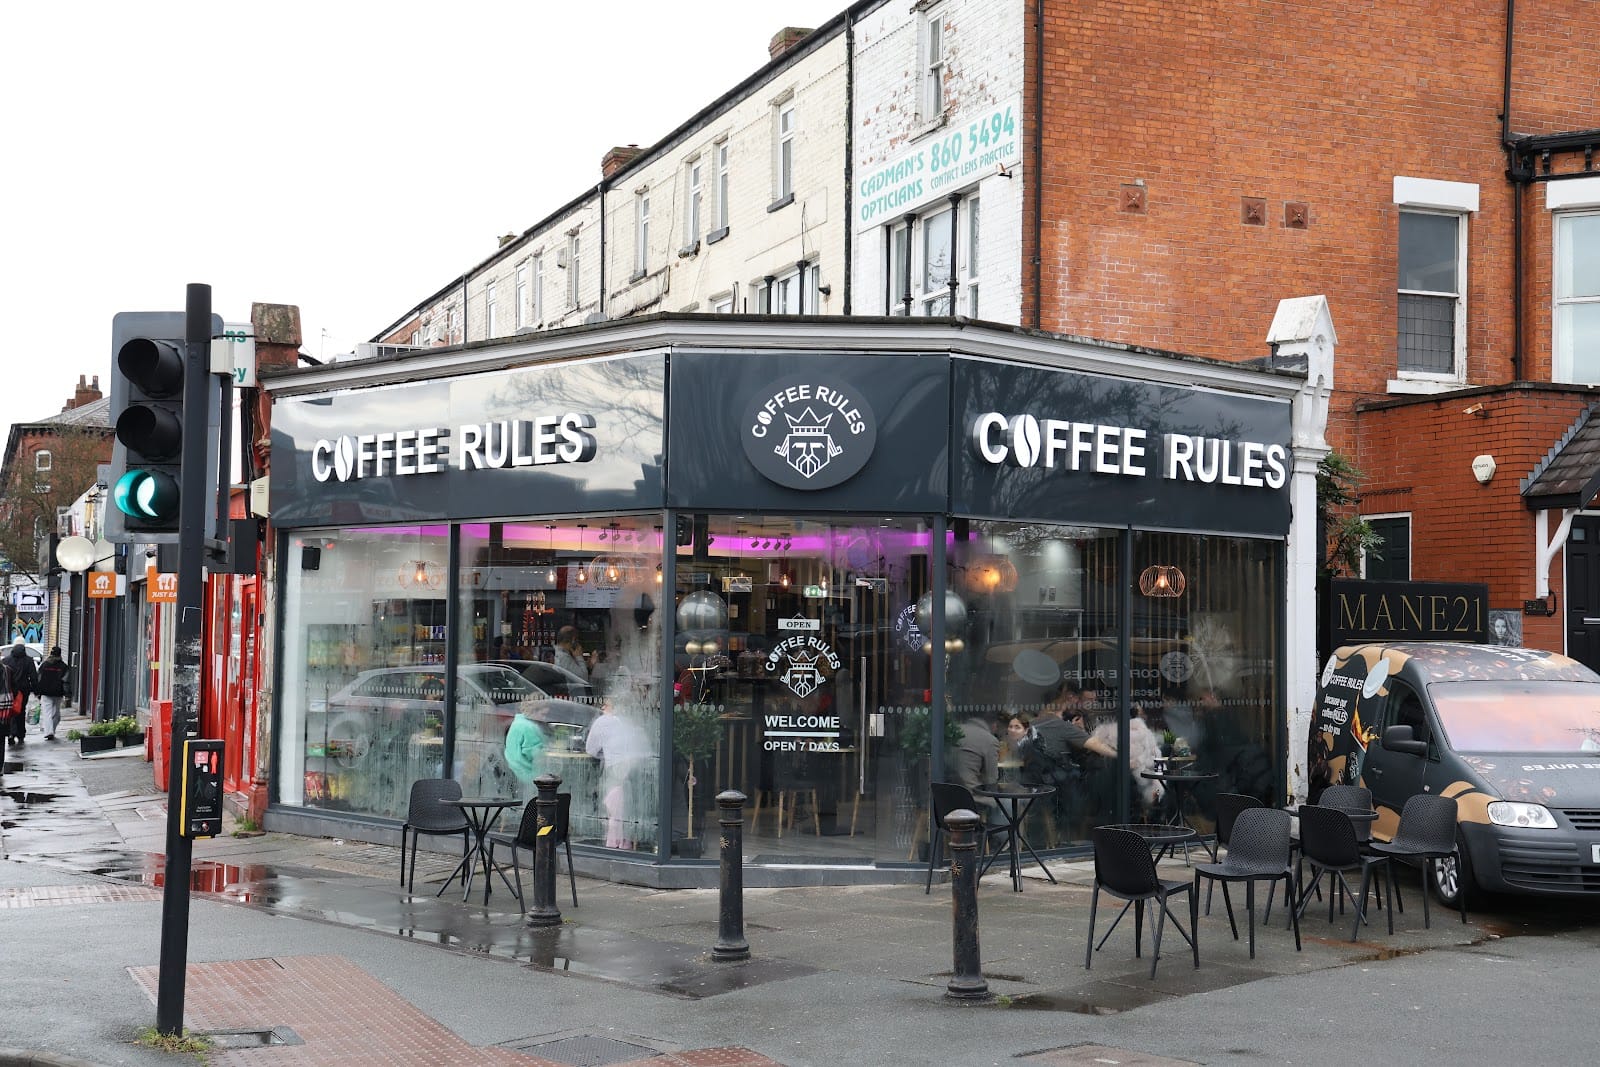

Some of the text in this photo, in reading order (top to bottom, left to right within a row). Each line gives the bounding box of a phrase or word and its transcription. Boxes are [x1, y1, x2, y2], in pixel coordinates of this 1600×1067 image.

[931, 106, 1015, 172] 860 5494
[861, 151, 925, 198] CADMAN'S
[930, 141, 1015, 190] CONTACT LENS PRACTICE
[861, 178, 923, 221] OPTICIANS
[752, 384, 866, 438] COFFEE RULES
[311, 412, 597, 483] COFFEE RULES
[975, 411, 1286, 489] COFFEE RULES
[786, 620, 812, 629] OPEN
[1337, 593, 1484, 633] MANE21
[765, 635, 841, 671] COFFEE RULES
[764, 714, 840, 729] WELCOME
[763, 741, 840, 751] OPEN 7 DAYS
